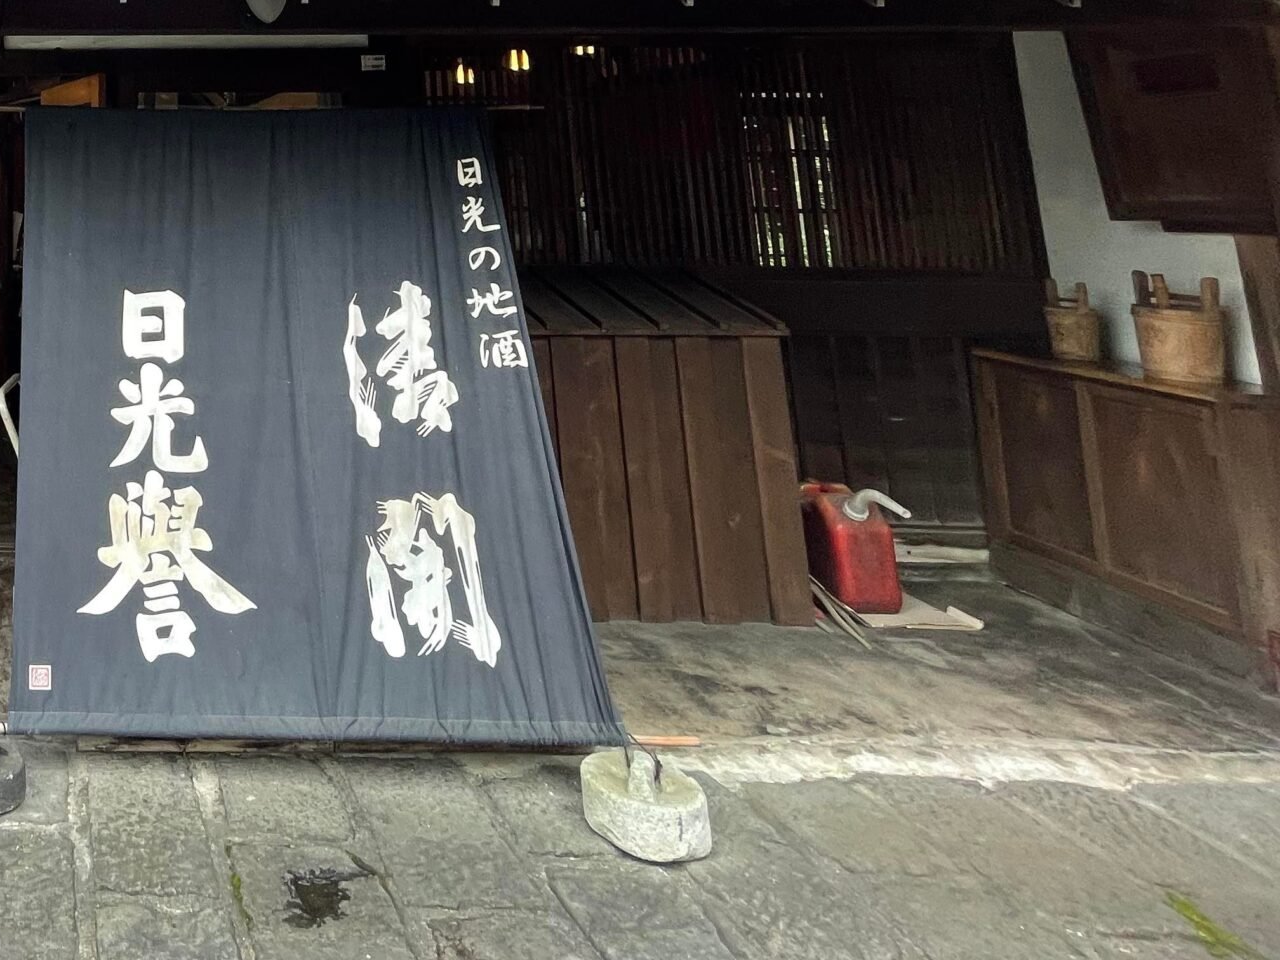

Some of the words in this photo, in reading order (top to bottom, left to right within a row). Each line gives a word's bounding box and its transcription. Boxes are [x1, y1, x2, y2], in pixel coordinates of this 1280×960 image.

[455, 156, 529, 370] 日光の地酒
